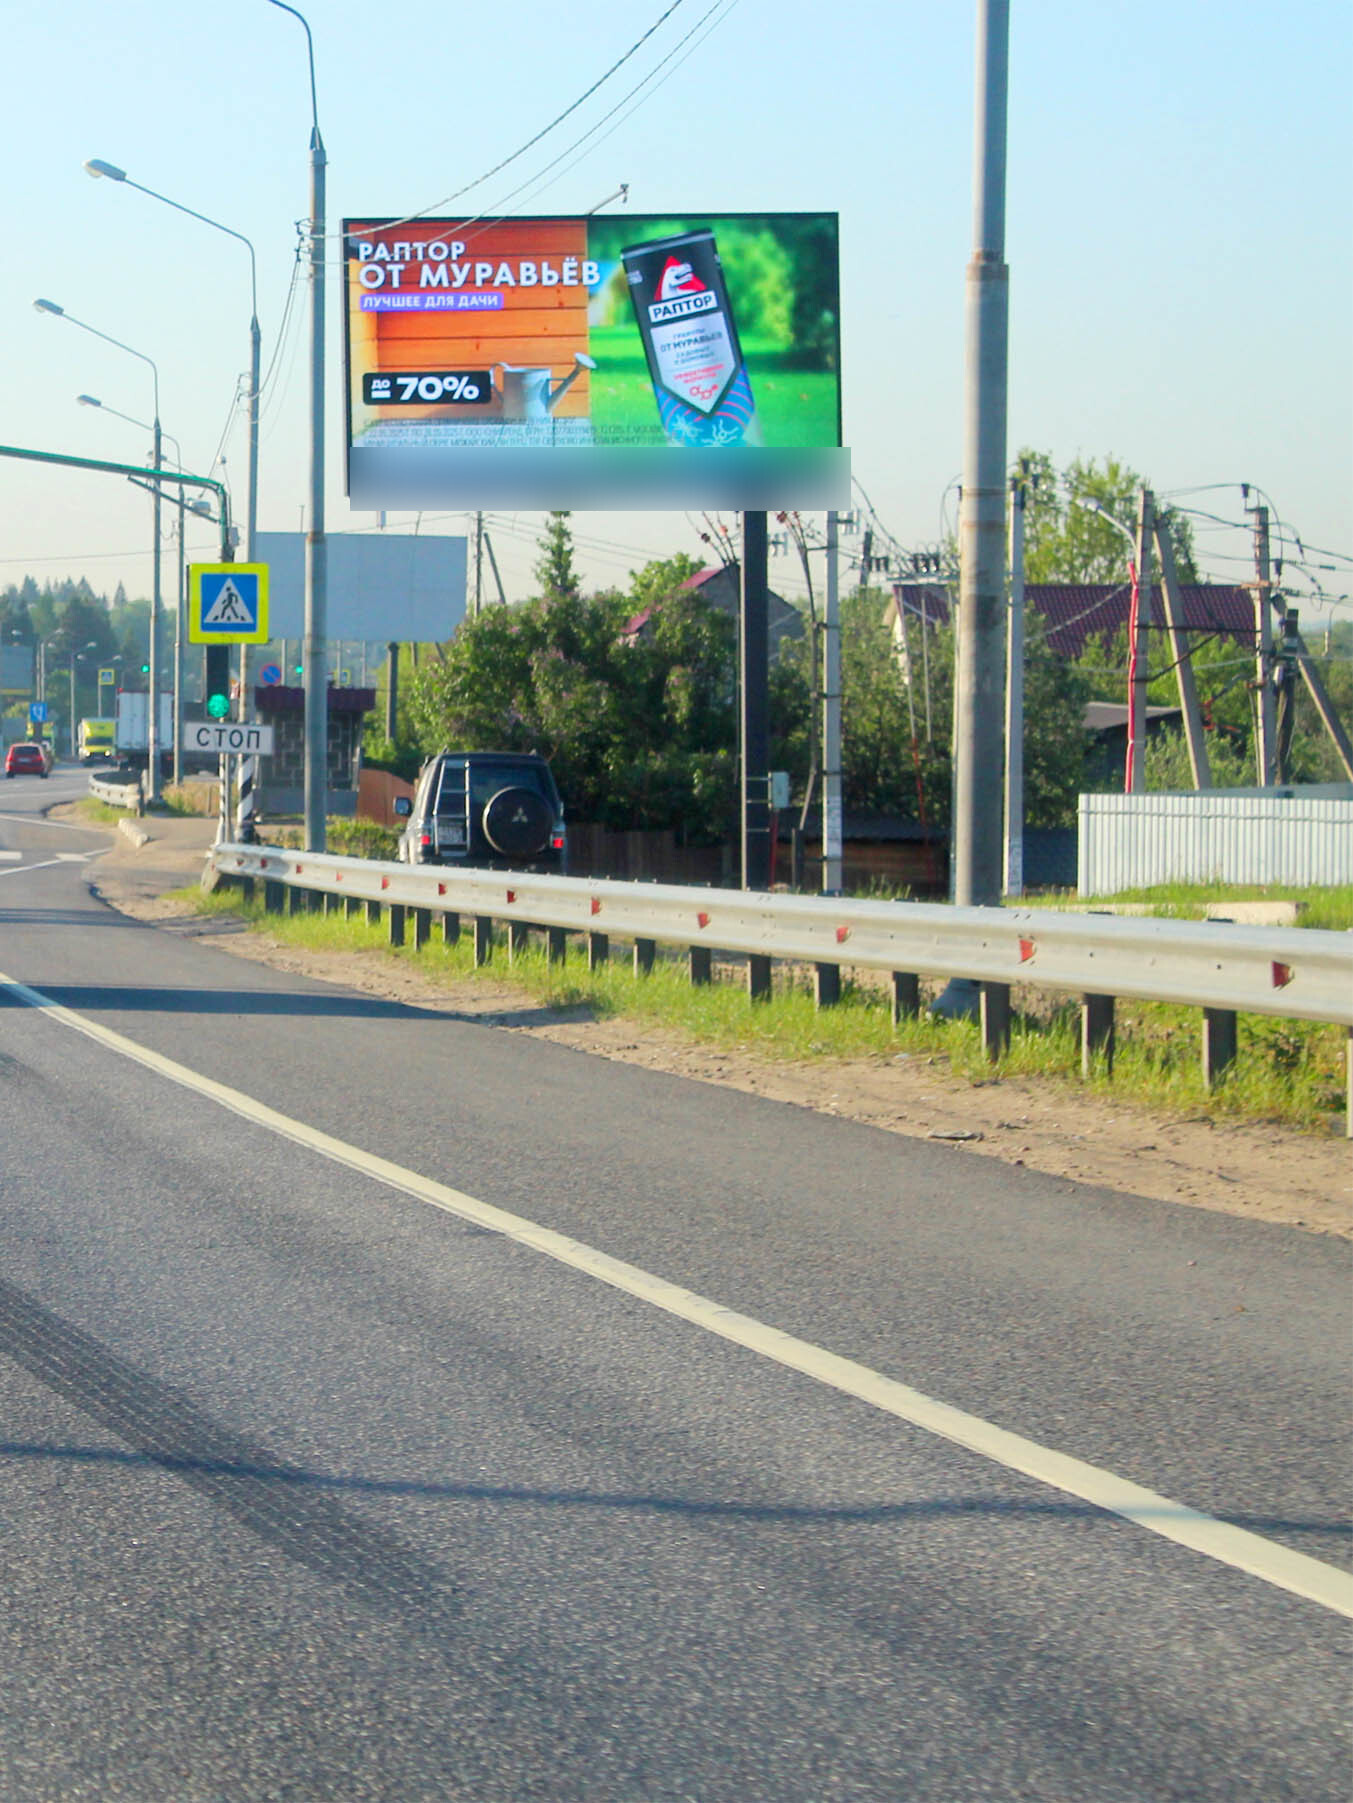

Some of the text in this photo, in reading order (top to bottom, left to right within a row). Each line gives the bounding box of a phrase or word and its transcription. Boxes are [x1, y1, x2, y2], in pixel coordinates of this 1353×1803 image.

[358, 241, 466, 262] РАПТОР
[359, 262, 406, 289] ОТ
[418, 257, 601, 288] МУРАВЬЁВ
[362, 294, 499, 309] ЛУЧШЕЕ ДЛЯ ДАЧИ
[652, 294, 713, 319] РАПТОР
[196, 727, 261, 749] СТОП
